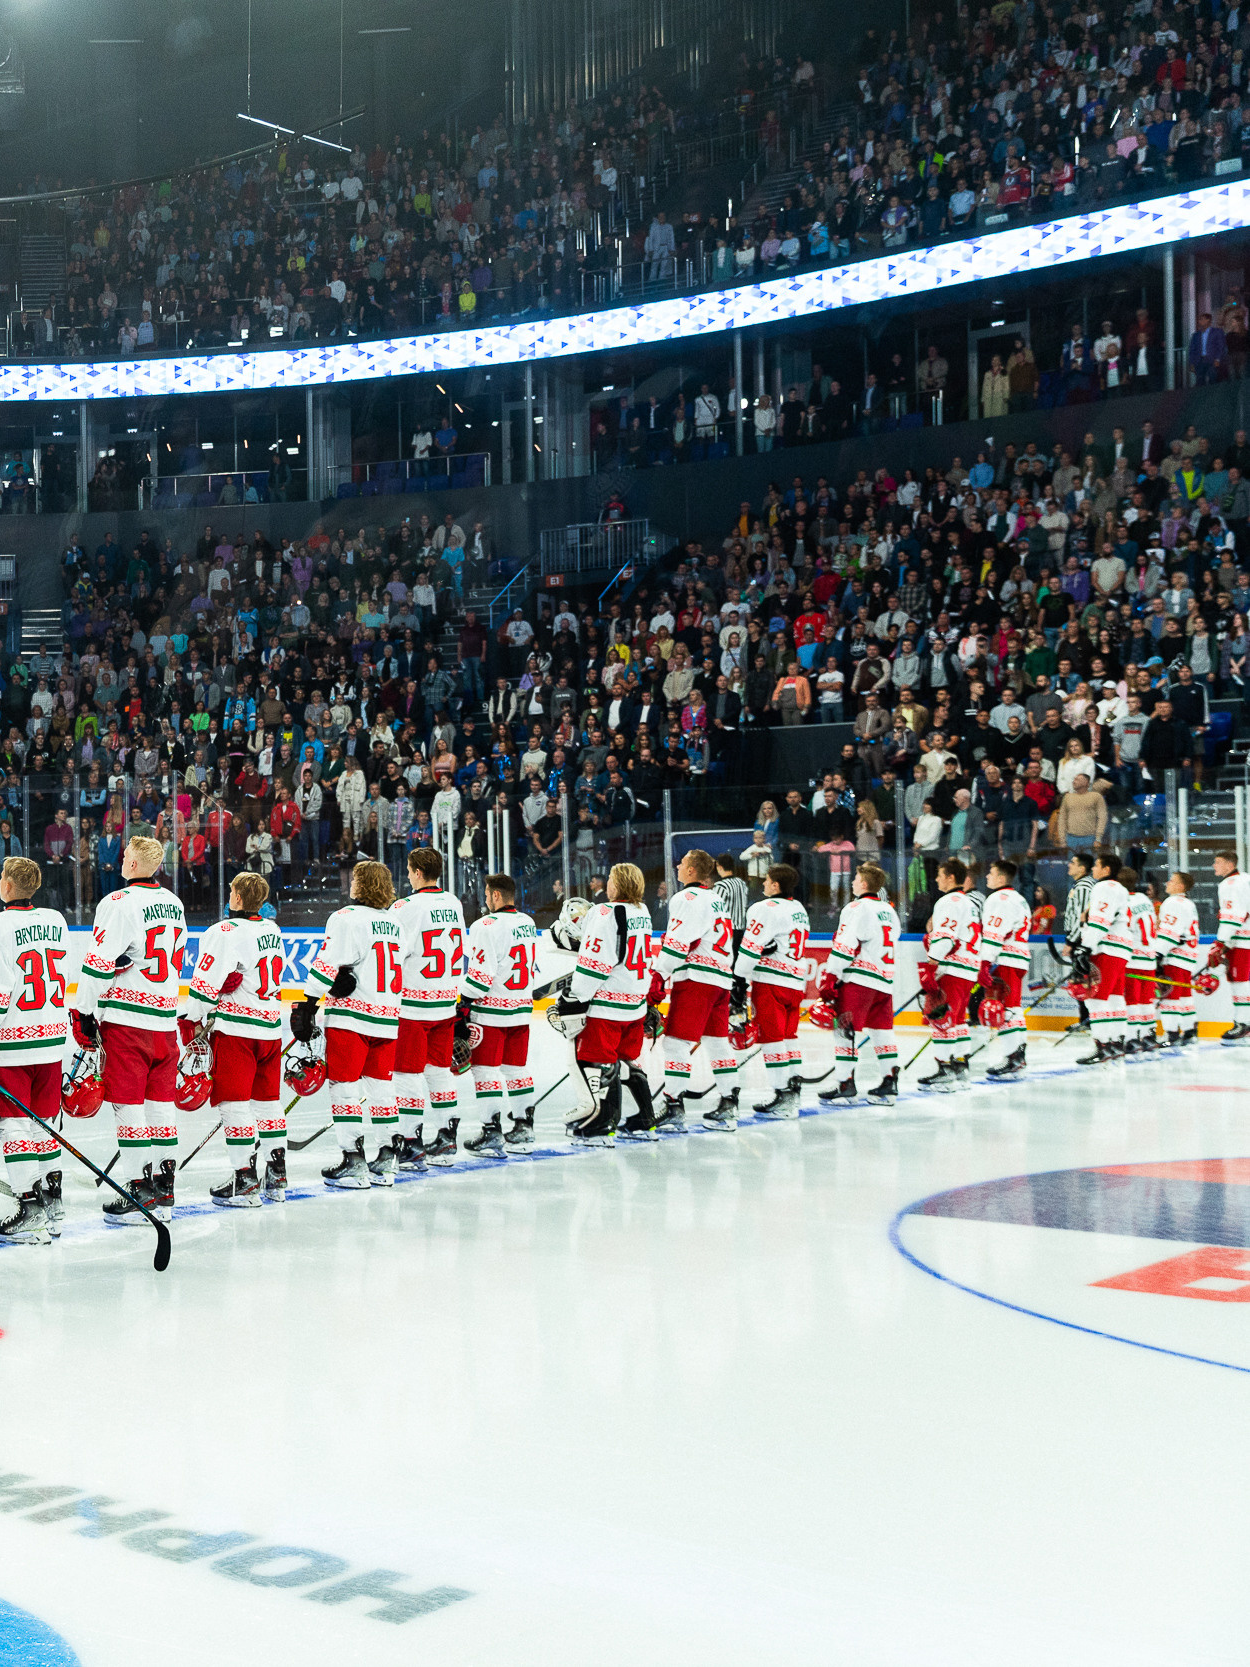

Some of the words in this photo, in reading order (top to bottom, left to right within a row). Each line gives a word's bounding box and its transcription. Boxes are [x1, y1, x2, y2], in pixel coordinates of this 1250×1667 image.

[429, 909, 460, 924] NEVERA
[940, 917, 958, 932] 22
[987, 915, 1003, 928] 20
[747, 918, 764, 936] 36
[198, 952, 215, 972] 19
[420, 928, 464, 979] 52
[371, 941, 403, 995] 15
[15, 947, 67, 1012] 35
